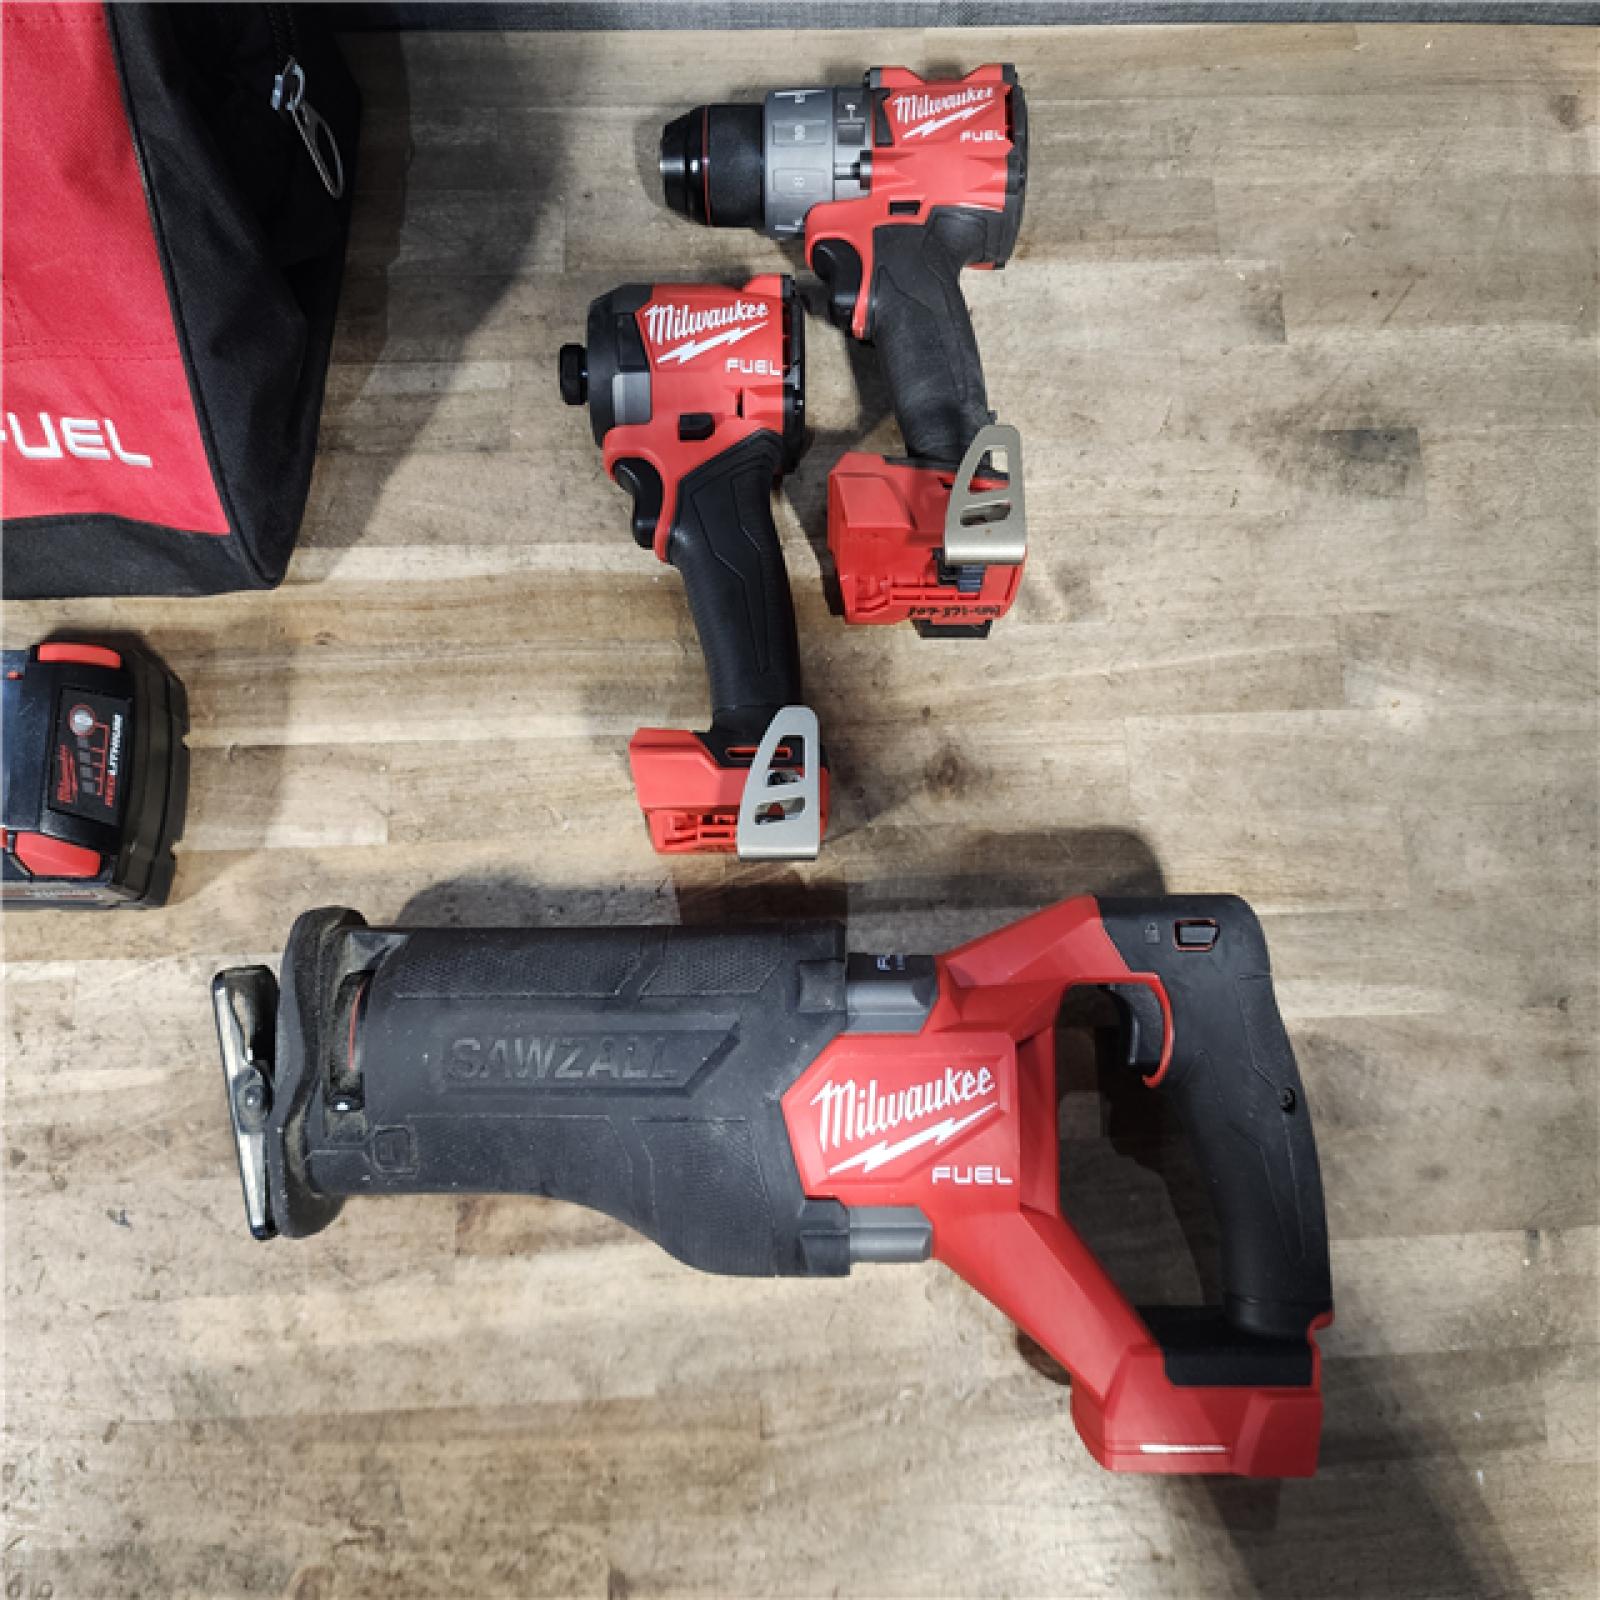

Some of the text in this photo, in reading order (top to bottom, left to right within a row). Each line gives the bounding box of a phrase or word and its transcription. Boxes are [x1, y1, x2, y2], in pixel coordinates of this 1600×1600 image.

[960, 130, 1005, 142] FUEL
[645, 300, 768, 345] Milwaukee
[725, 358, 781, 375] FUEL
[2, 412, 152, 468] UEL
[448, 1037, 678, 1079] SAWZALL
[810, 1067, 995, 1152] Milwaukee
[931, 1165, 1013, 1185] FUEL
